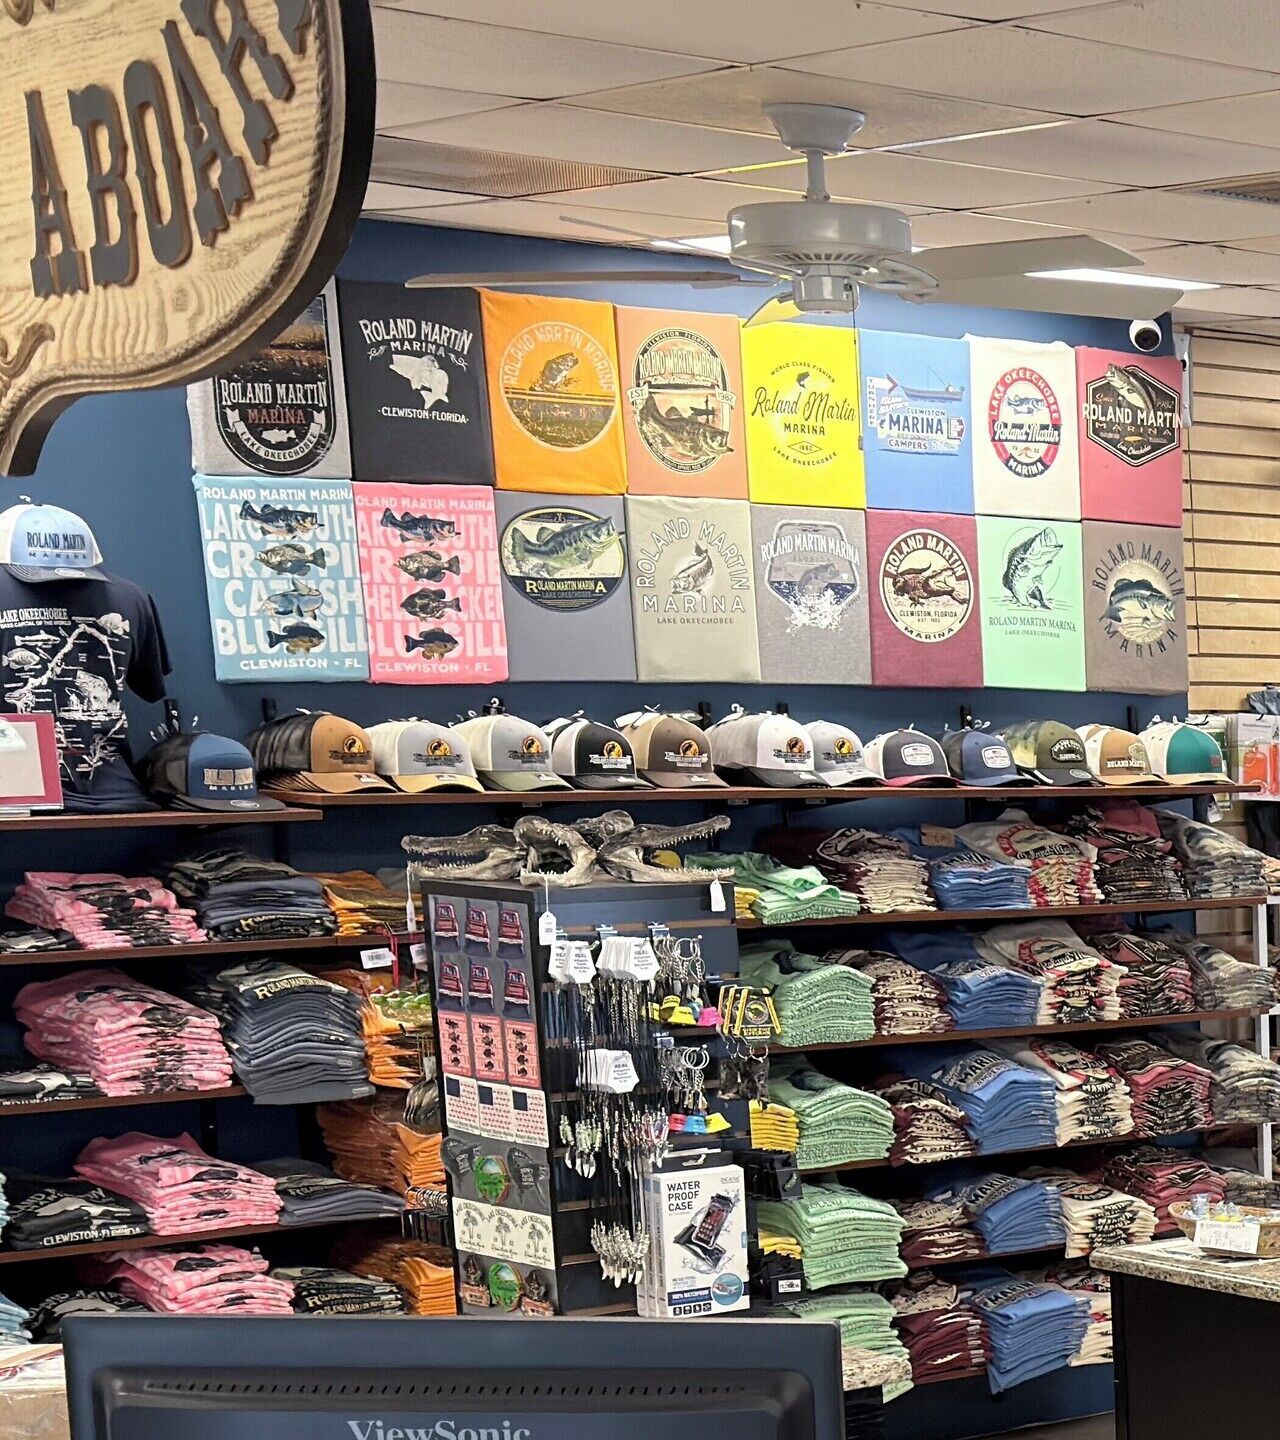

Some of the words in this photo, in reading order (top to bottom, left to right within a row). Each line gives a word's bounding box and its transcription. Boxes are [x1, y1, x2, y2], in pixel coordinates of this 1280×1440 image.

[24, 0, 313, 299] ABOAR
[359, 319, 416, 344] ROLAND
[420, 320, 473, 353] MARTIN
[391, 340, 446, 358] MARINA
[503, 334, 535, 385] ROLAND
[535, 326, 583, 347] MARTIN
[770, 363, 790, 376] WORLD
[220, 379, 271, 406] ROLAND
[276, 380, 327, 407] MARTIN
[990, 380, 1005, 415] LAKE
[1004, 368, 1058, 420] OKEECHOBEE
[752, 386, 802, 418] Roland
[803, 391, 856, 423] Martin
[906, 407, 946, 417] CLEWISTON
[247, 408, 306, 425] MARINA
[382, 406, 430, 419] CLEWISTON
[431, 410, 467, 423] FLORIDA
[1083, 403, 1132, 424] ROLAND
[1137, 407, 1183, 429] MARTIN
[783, 422, 826, 436] MARINA
[888, 413, 944, 435] MARINA
[994, 420, 1026, 441] Roland
[1026, 422, 1059, 442] Martin
[1095, 422, 1172, 435] MARINA
[240, 430, 261, 454] LAKE
[888, 439, 928, 450] CAMPERS
[773, 446, 790, 461] LAKE
[1008, 457, 1044, 476] MARINA
[203, 486, 256, 500] ROLAND
[260, 487, 306, 500] MARTIN
[355, 496, 397, 509] OLAND
[401, 498, 446, 510] MARTIN
[450, 499, 494, 511] MARINA
[27, 532, 60, 548] ROLAND
[62, 534, 86, 549] MARTIN
[761, 536, 793, 563] ROLAND
[794, 533, 827, 552] MARTIN
[828, 536, 860, 565] MARINA
[636, 517, 691, 588] ROLAND
[698, 520, 750, 591] MARTIN
[885, 535, 924, 574] ROLAND
[926, 536, 966, 579] MARTIN
[1092, 541, 1135, 591] ROLAND
[1140, 542, 1184, 597] MARTIN
[526, 579, 556, 593] ROLAND
[642, 595, 746, 613] MARINA
[19, 608, 68, 620] OKEECHOBEE
[899, 610, 932, 618] CLEWISTON,
[989, 616, 1018, 626] ROLAND
[1019, 618, 1047, 629] MARTIN
[1049, 620, 1076, 631] MARINA
[904, 626, 954, 641] MARINA
[1104, 621, 1178, 658] MARINA
[240, 658, 328, 671] CLEWISTON
[344, 657, 362, 669] FL
[375, 662, 459, 673] CLEWISTON
[475, 663, 492, 673] FL
[667, 1180, 701, 1192] WATER
[668, 1191, 699, 1202] PROOF
[668, 1201, 693, 1212] CASE
[43, 1229, 98, 1246] CLEWISTON
